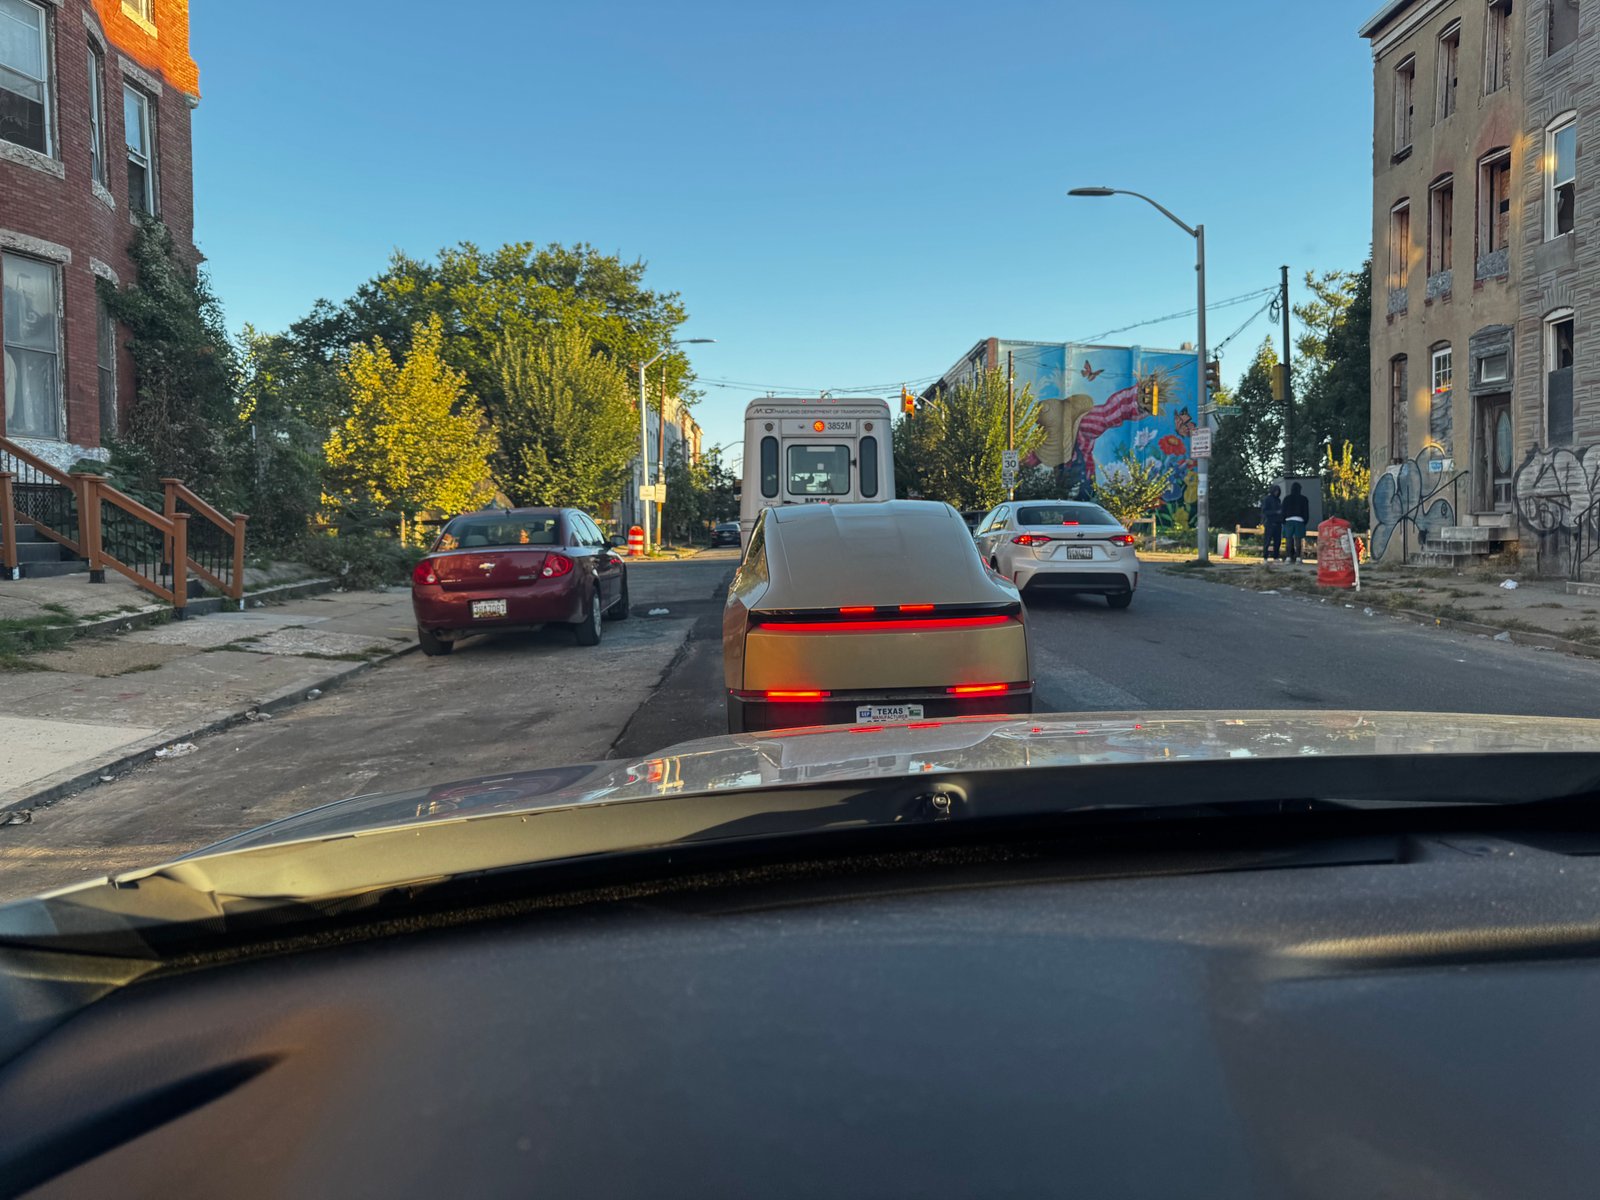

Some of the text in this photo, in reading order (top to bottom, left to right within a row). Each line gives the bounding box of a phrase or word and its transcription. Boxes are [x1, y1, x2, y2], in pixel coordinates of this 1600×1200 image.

[827, 421, 852, 430] 3852M
[1004, 460, 1017, 468] 30
[877, 707, 904, 715] TEXAS
